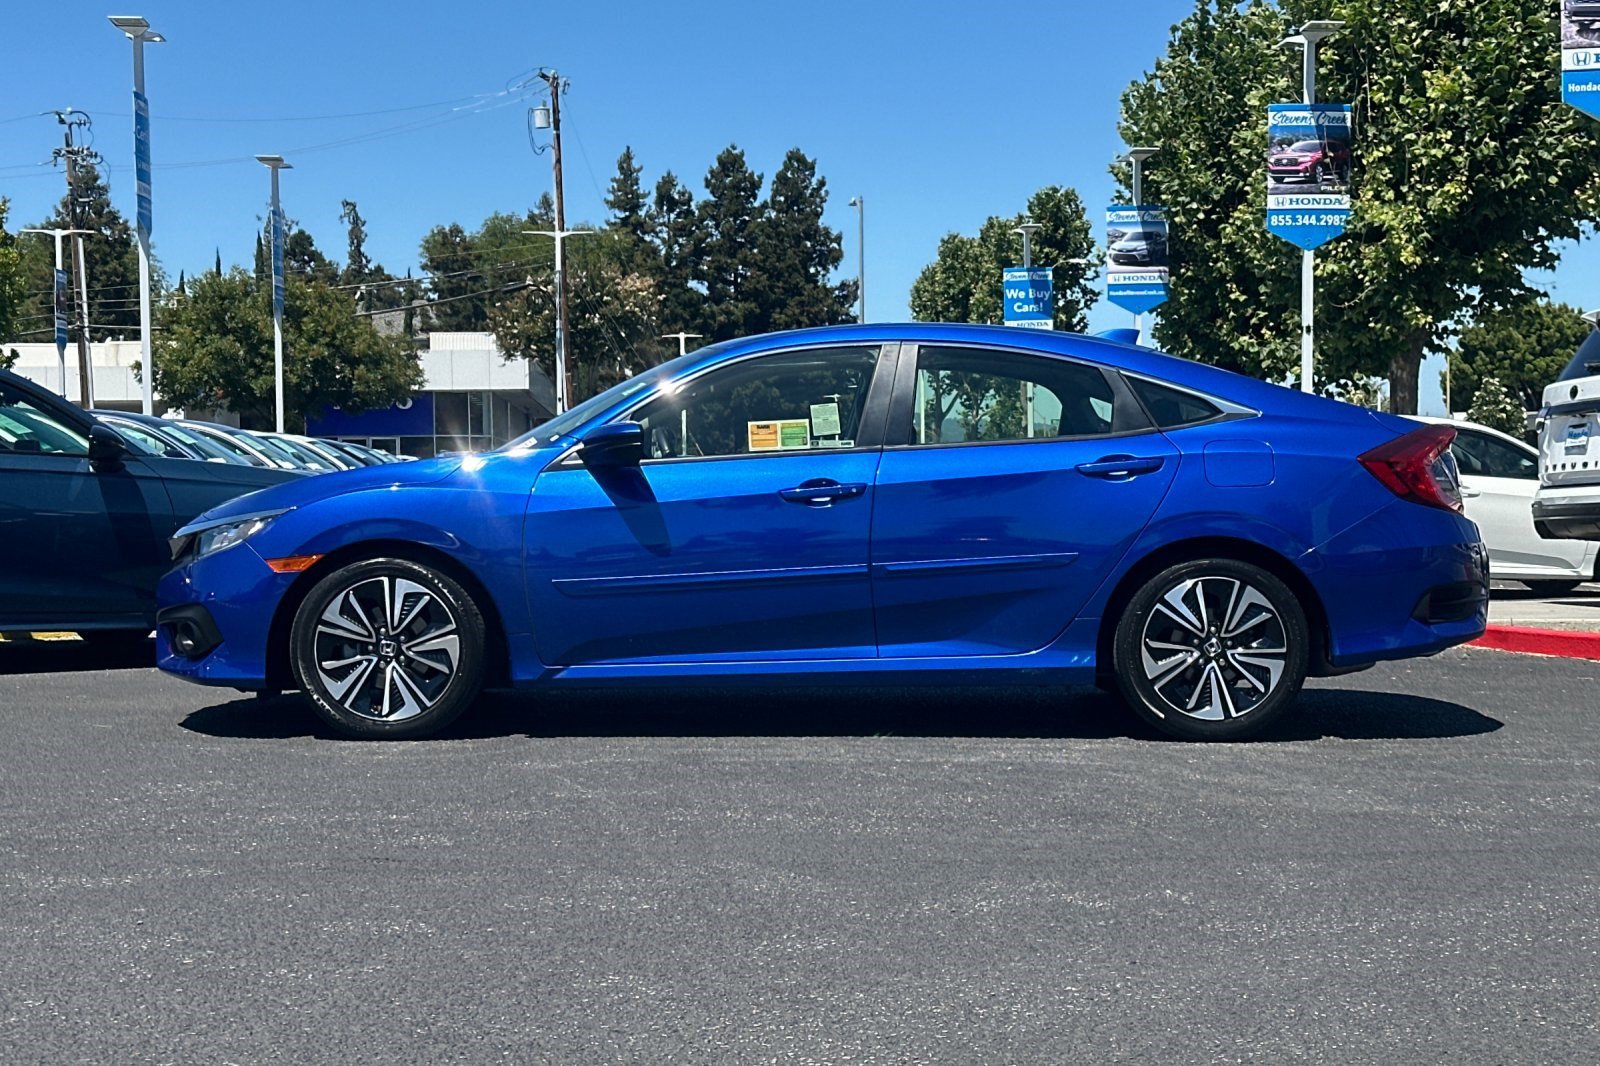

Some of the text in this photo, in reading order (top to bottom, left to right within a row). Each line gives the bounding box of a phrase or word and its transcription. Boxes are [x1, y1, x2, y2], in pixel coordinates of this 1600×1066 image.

[1271, 110, 1348, 125] Stevens Creek
[1288, 198, 1343, 206] HONDA
[1271, 215, 1346, 226] 855.344.2987
[1005, 288, 1051, 301] We Buy
[1013, 301, 1044, 313] Cars!
